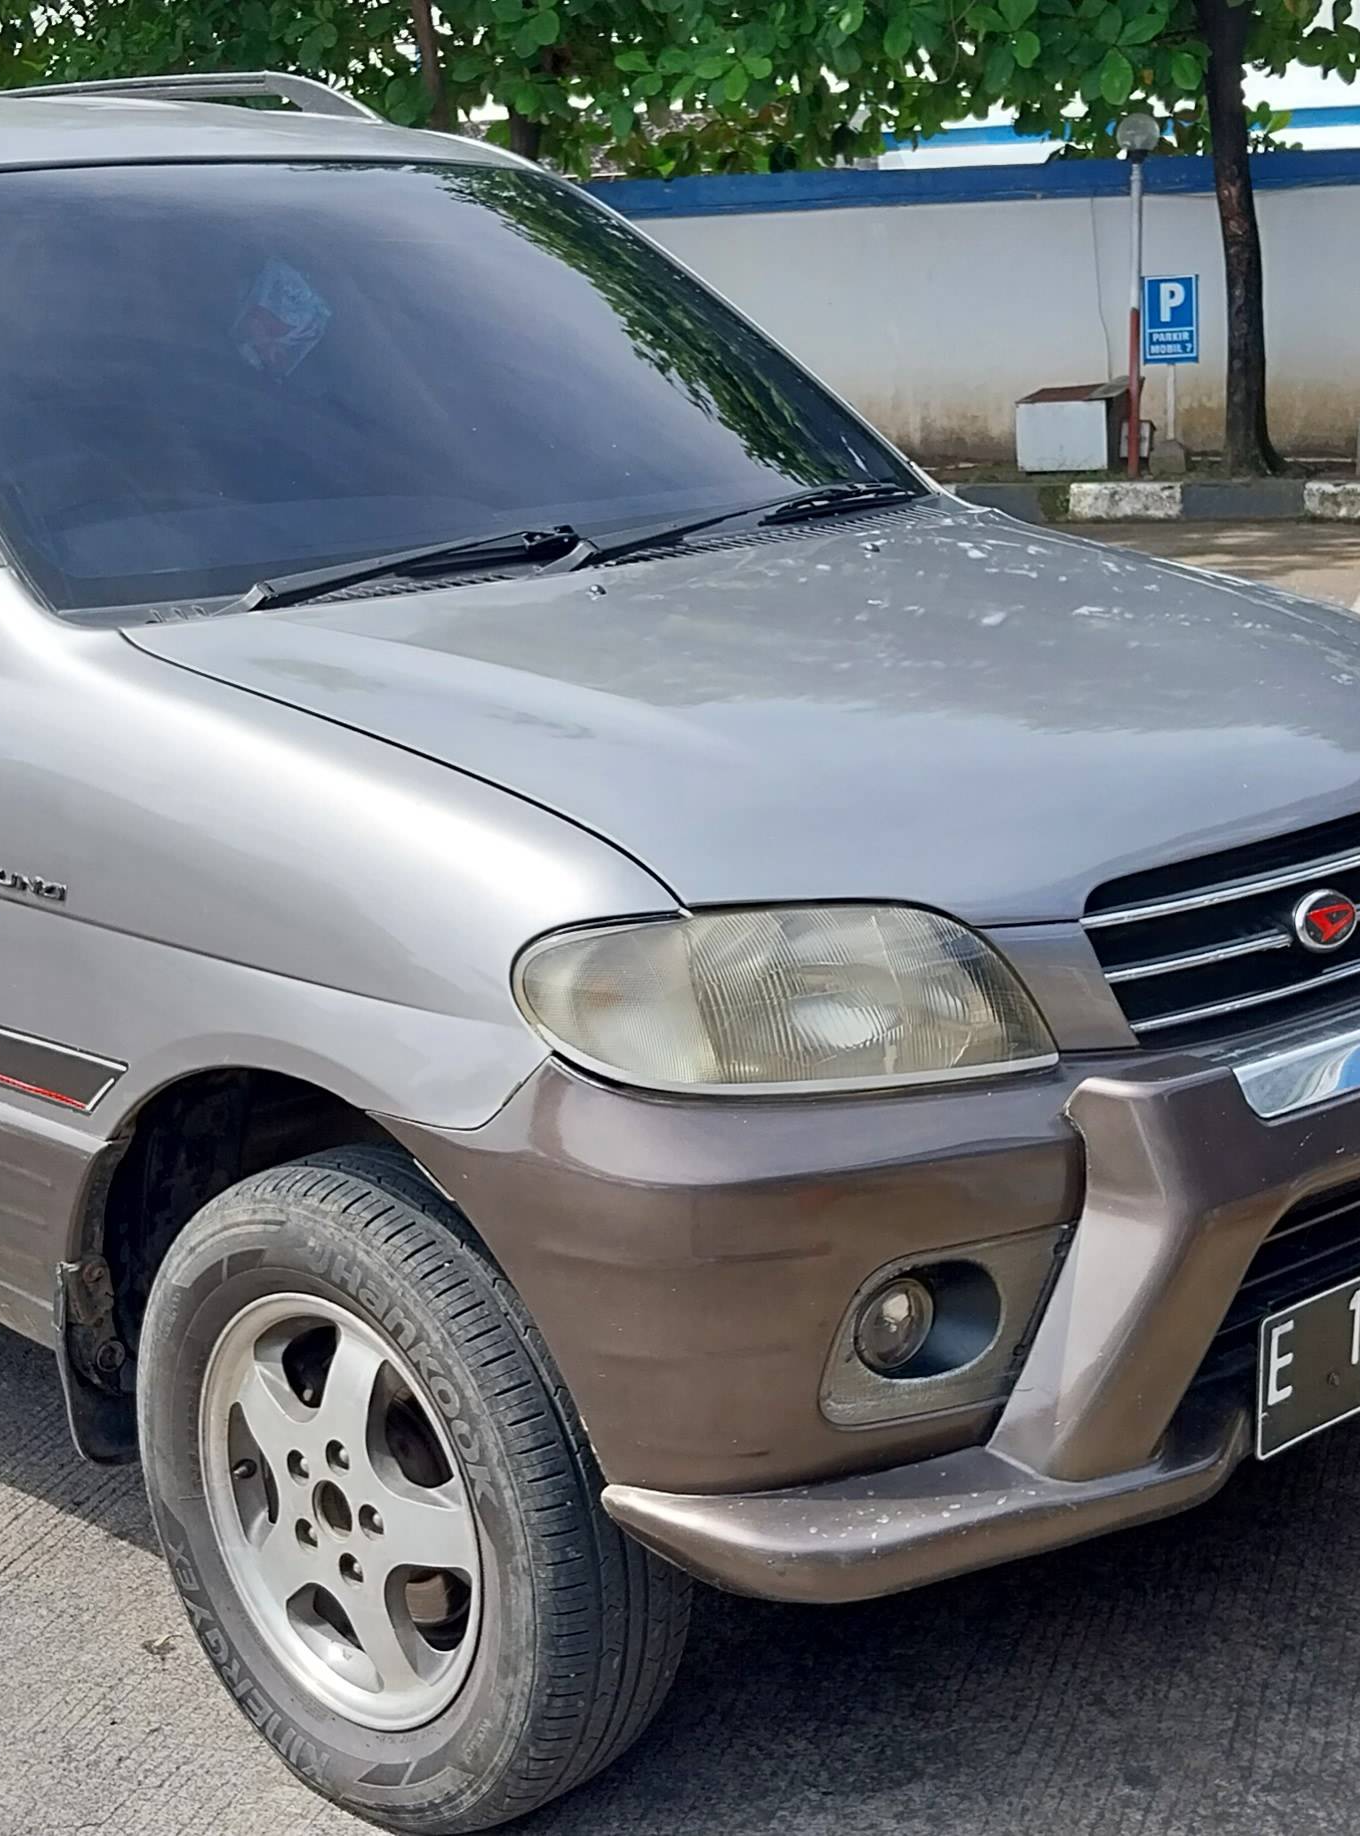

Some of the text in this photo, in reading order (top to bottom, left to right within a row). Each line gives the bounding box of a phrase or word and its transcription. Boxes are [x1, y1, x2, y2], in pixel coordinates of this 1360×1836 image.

[1160, 282, 1185, 322] P
[1150, 343, 1183, 354] MOBIL
[1152, 331, 1190, 342] PARKIR
[1267, 1320, 1294, 1405] E
